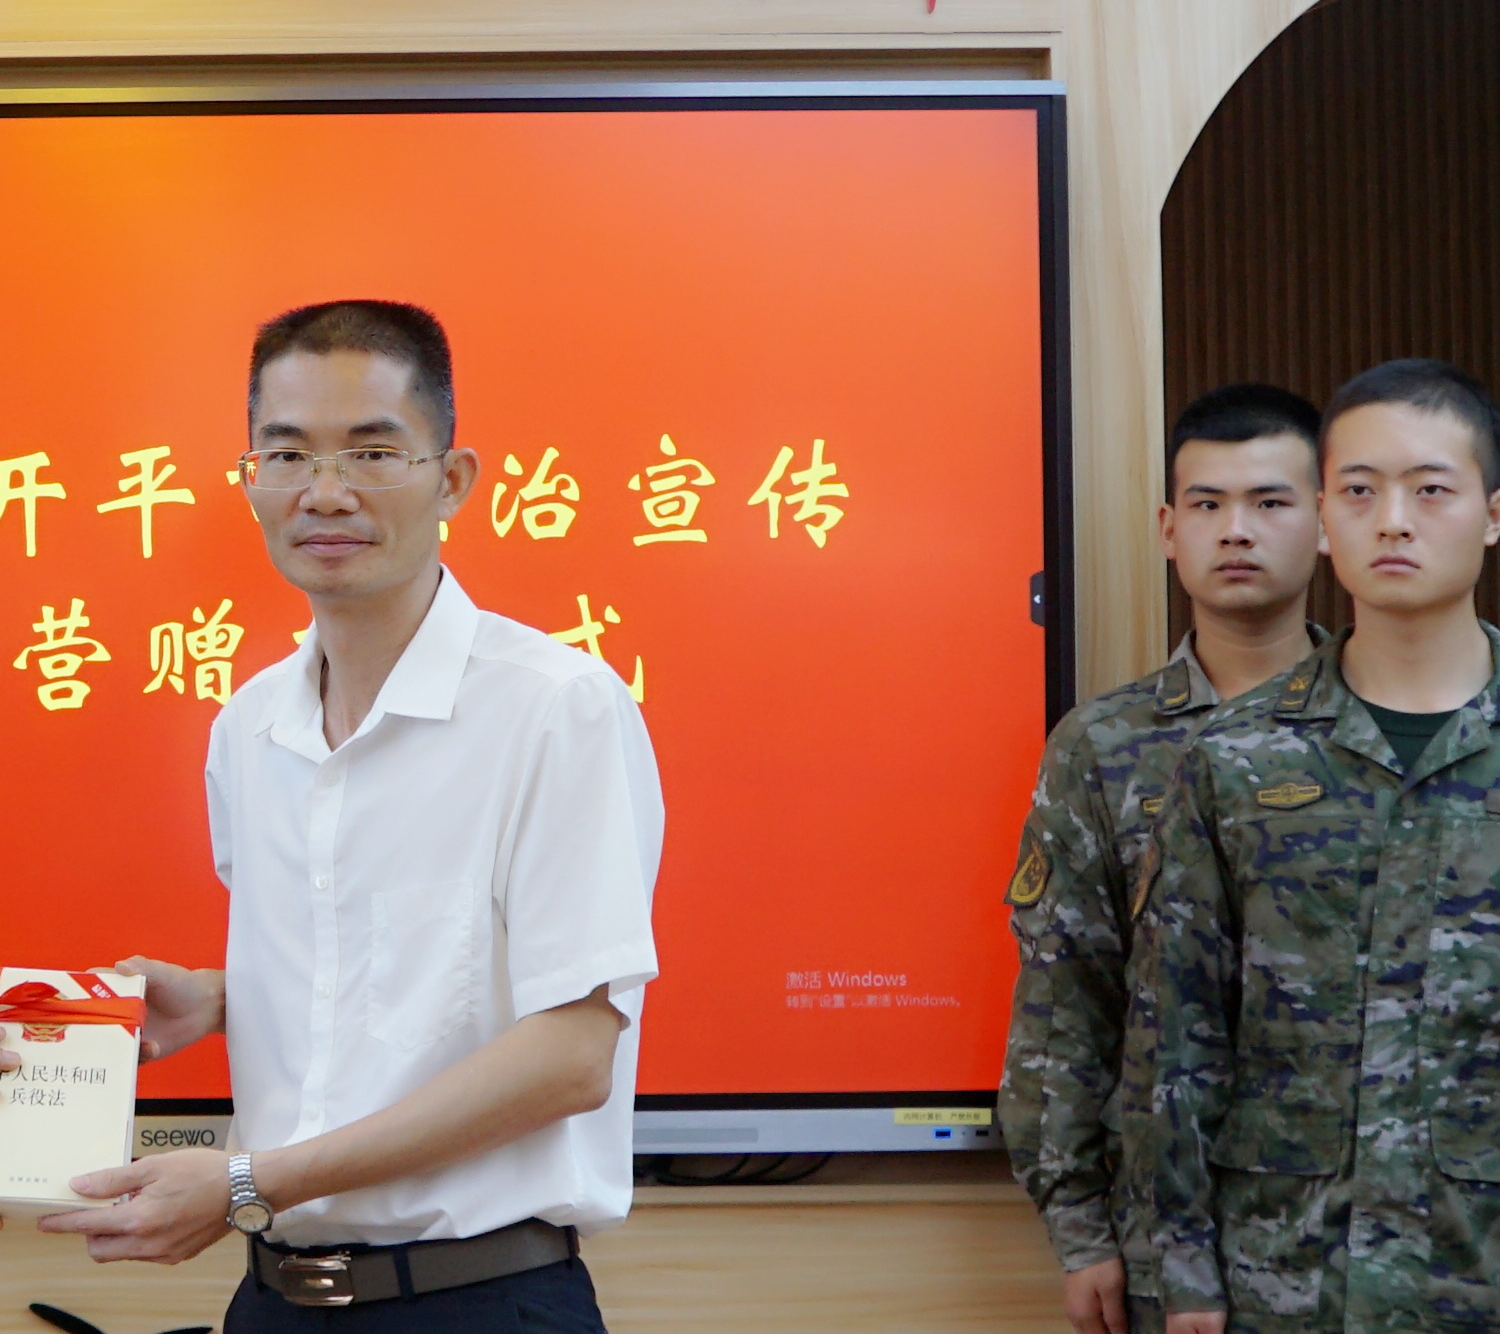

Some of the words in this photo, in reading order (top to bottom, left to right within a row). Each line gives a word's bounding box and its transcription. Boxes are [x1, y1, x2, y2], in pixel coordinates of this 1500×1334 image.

[828, 971, 907, 987] Windows
[9, 1087, 65, 1106] 兵役法
[141, 1127, 215, 1147] seewo
